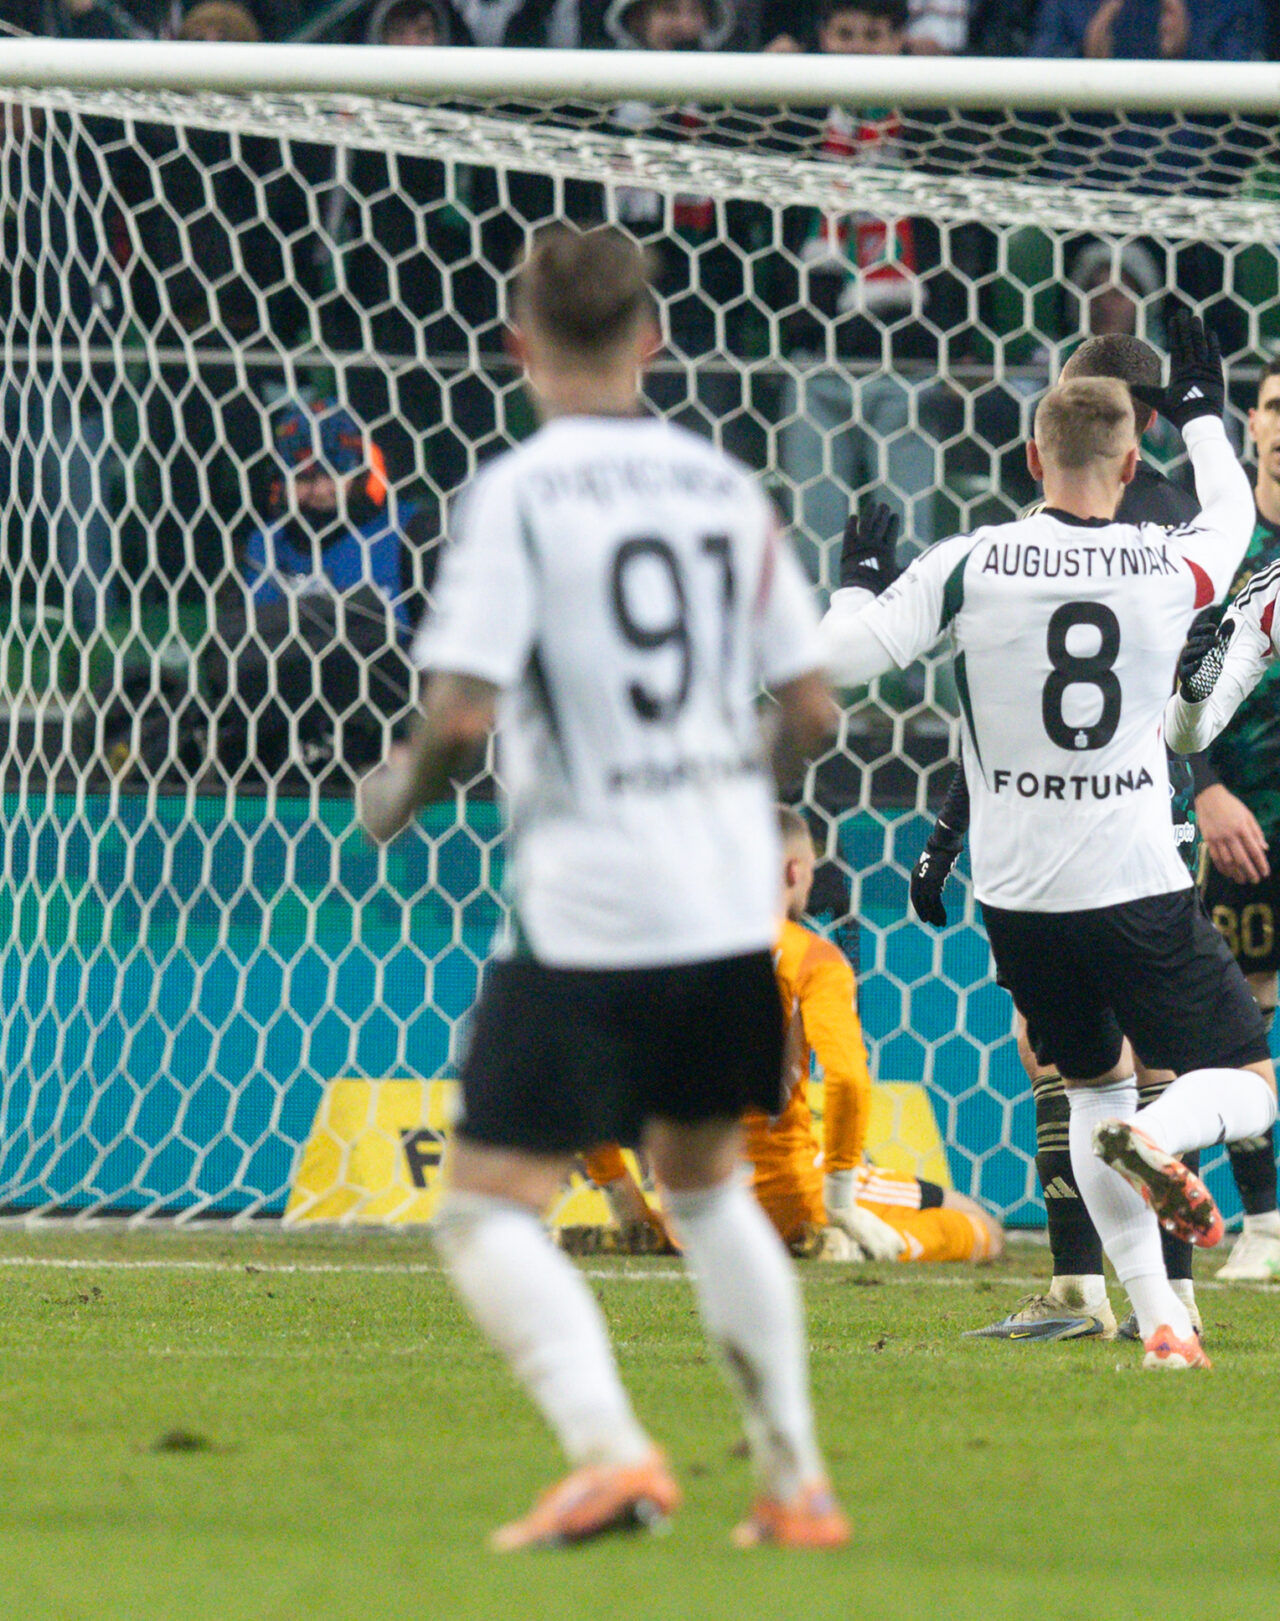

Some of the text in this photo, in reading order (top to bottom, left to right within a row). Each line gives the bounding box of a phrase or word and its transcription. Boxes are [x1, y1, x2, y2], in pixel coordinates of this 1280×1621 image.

[982, 543, 1180, 578] AUGUSTYNIAK
[610, 532, 736, 724] 91
[1042, 600, 1122, 751] 8
[993, 766, 1154, 801] FORTUNA
